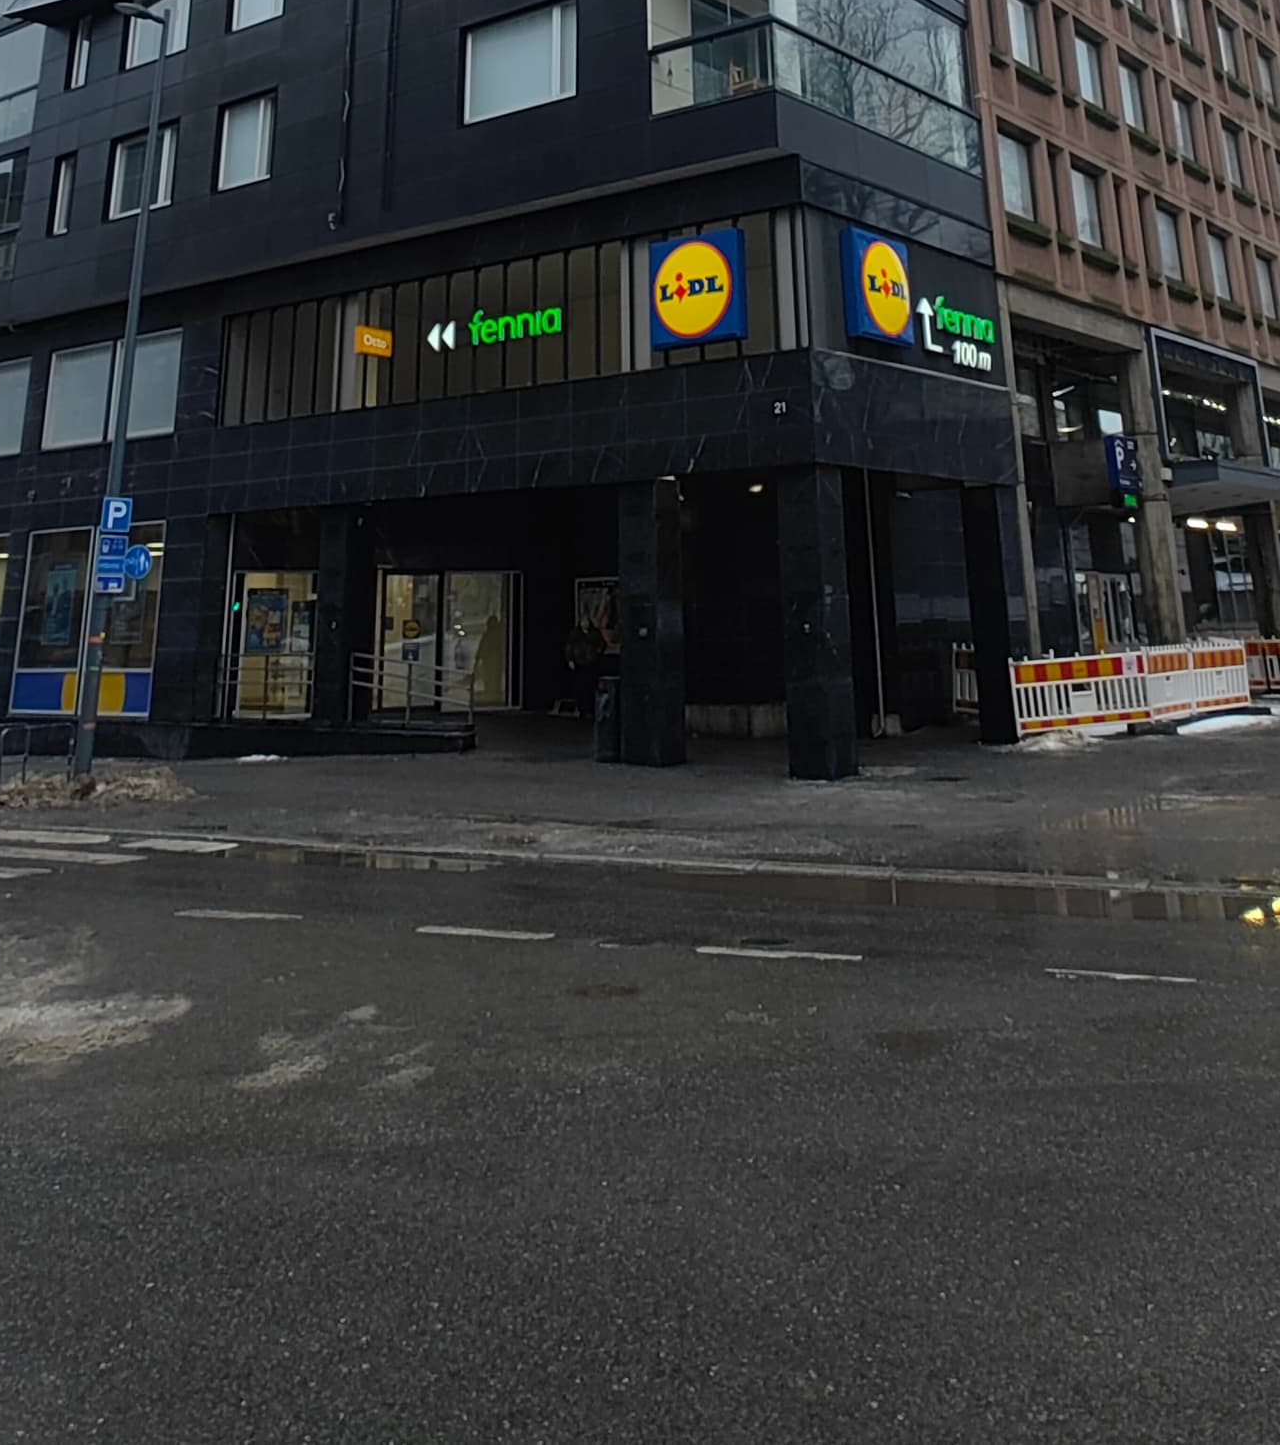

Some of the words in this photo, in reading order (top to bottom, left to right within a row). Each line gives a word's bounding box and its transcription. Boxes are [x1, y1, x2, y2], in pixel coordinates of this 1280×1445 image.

[468, 308, 562, 346] fennia
[933, 296, 995, 344] fennia
[952, 340, 977, 368] 100
[977, 351, 992, 372] m
[774, 401, 787, 414] 21
[107, 501, 127, 529] P
